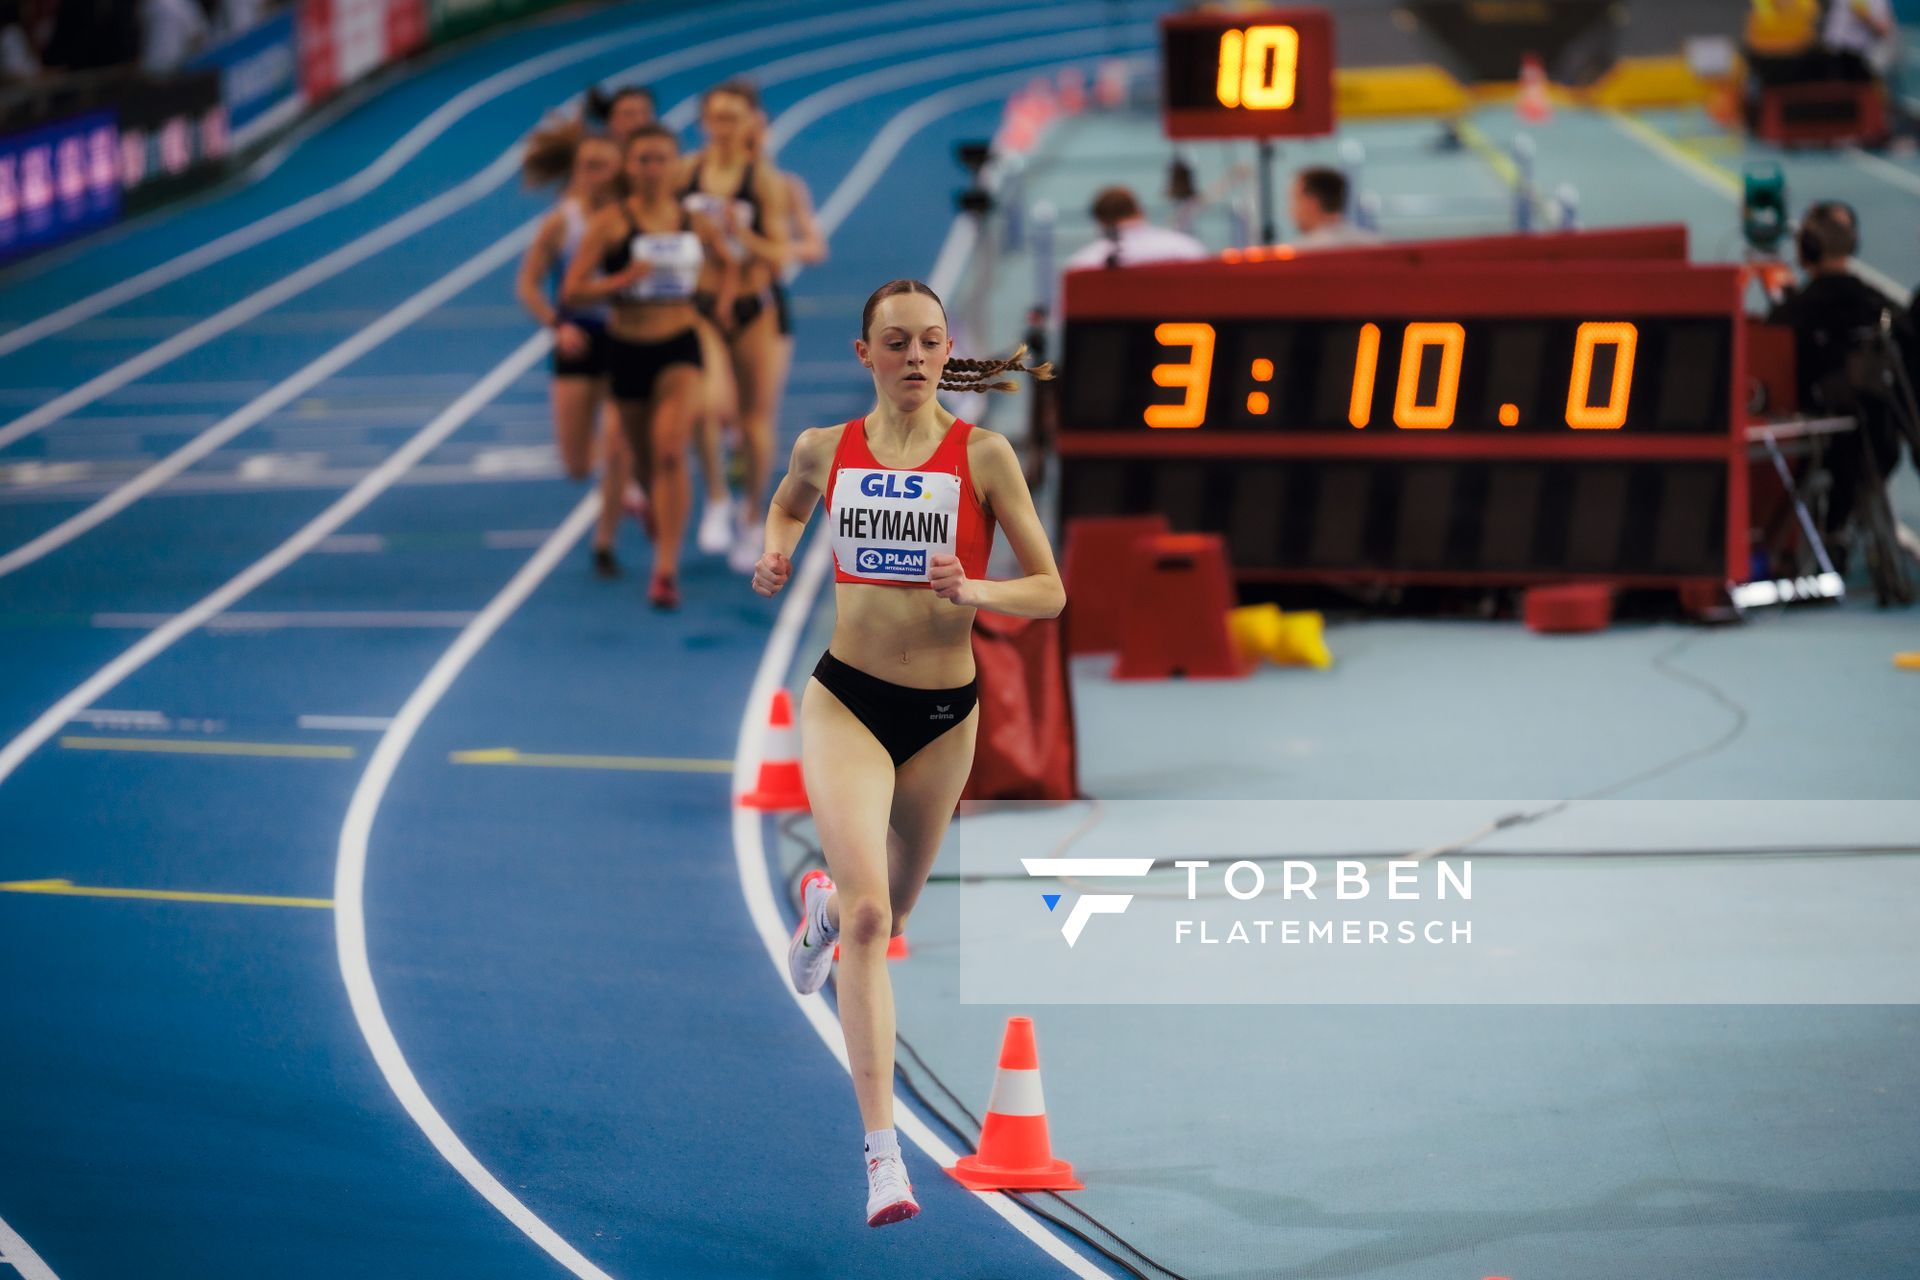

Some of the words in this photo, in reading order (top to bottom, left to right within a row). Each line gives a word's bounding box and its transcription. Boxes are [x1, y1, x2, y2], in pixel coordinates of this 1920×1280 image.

[1216, 25, 1299, 110] 10
[839, 507, 949, 544] HEYMANN
[885, 553, 923, 566] PLAN
